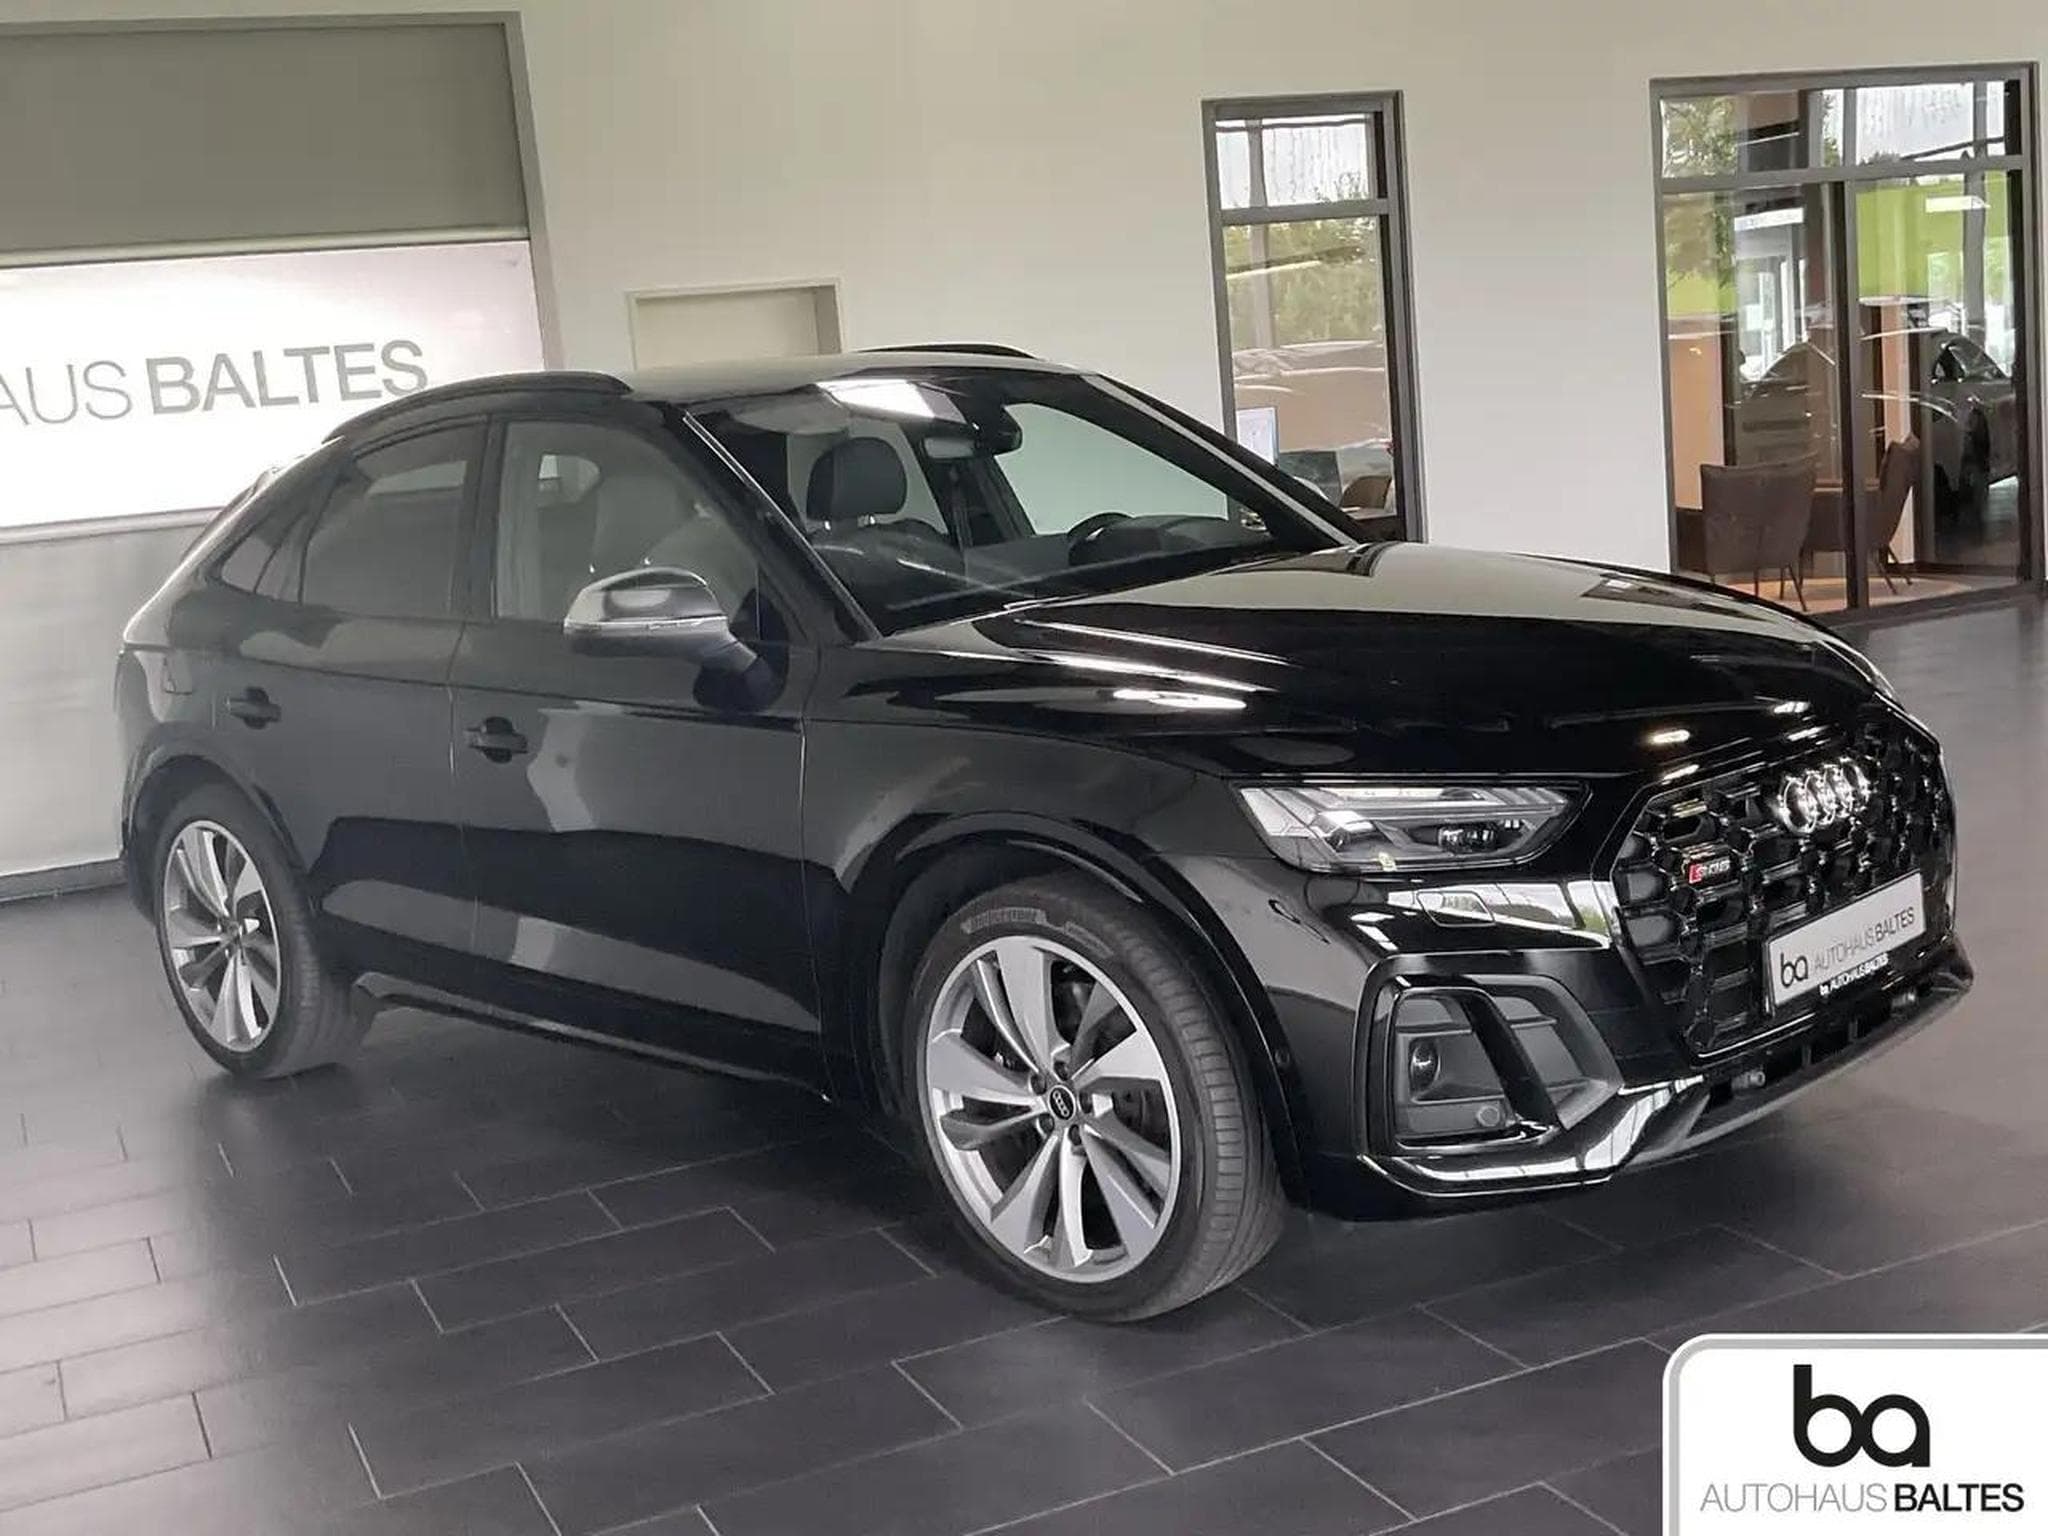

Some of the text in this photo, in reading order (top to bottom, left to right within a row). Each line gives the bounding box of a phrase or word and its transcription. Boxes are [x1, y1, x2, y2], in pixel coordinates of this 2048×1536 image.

[145, 339, 429, 414] BALTES
[1780, 952, 1809, 988] ba
[1814, 927, 1875, 972] AUTOHAUS
[1875, 906, 1916, 943] BALTES
